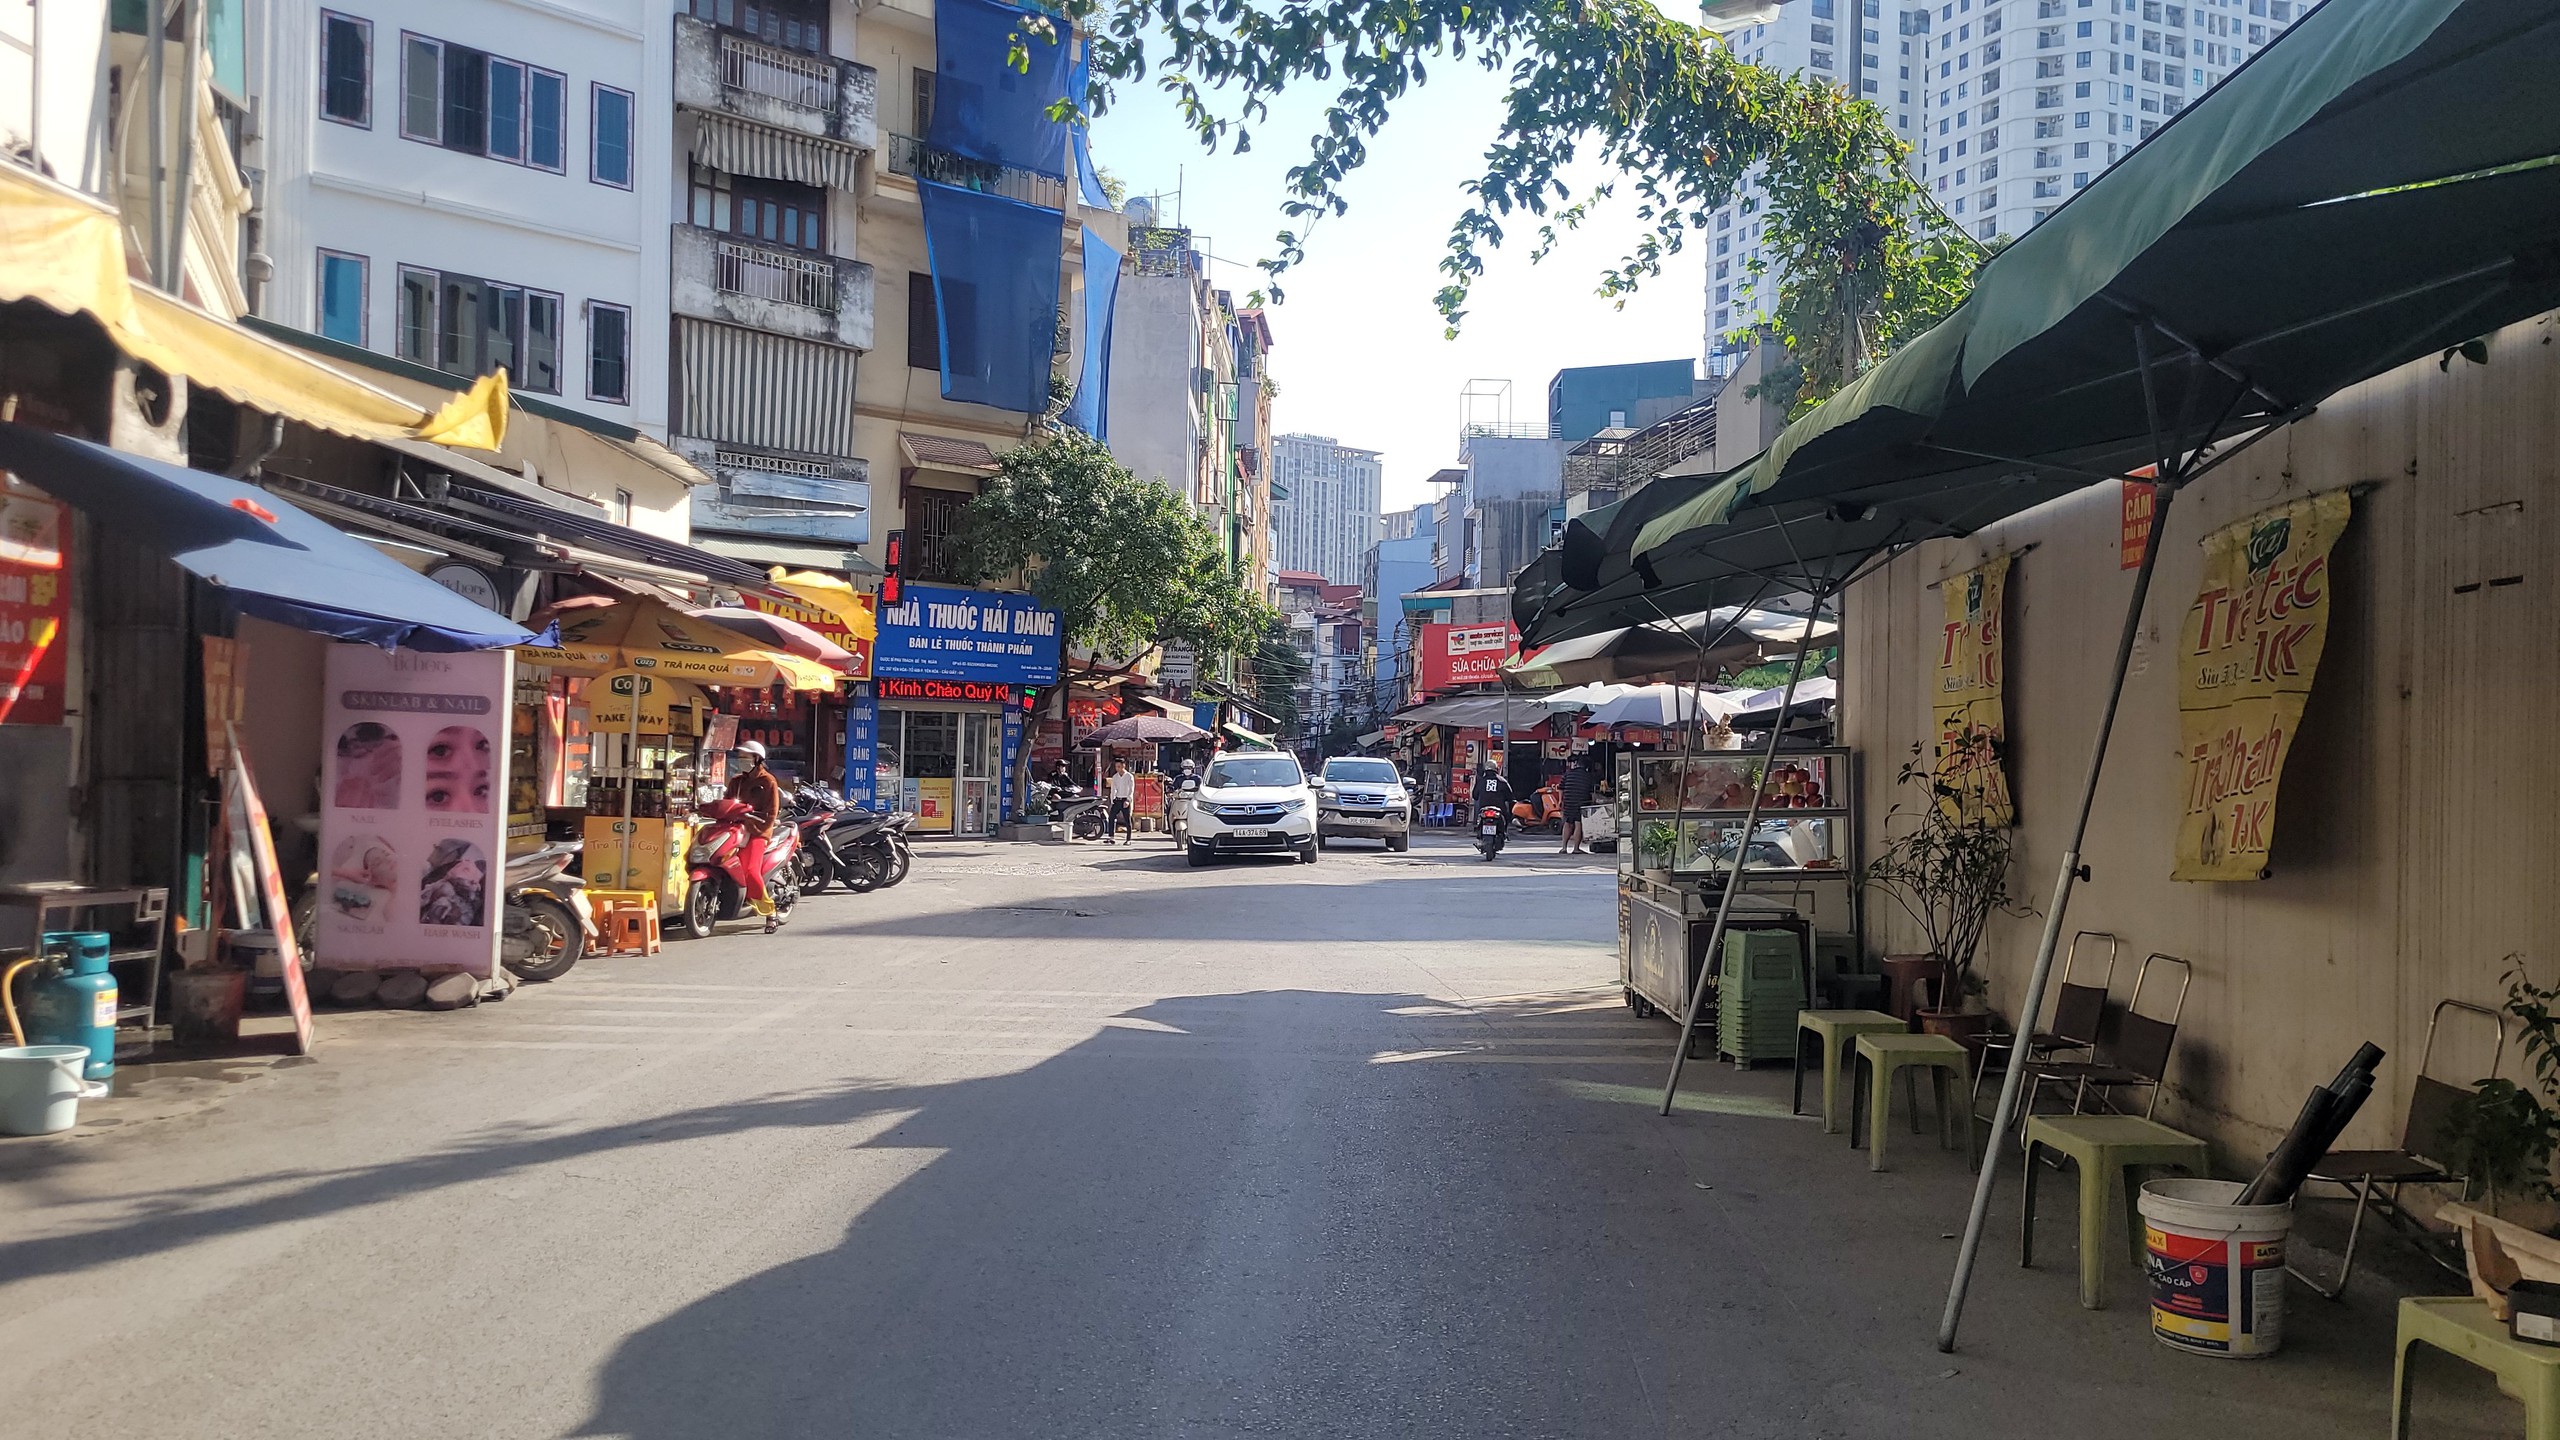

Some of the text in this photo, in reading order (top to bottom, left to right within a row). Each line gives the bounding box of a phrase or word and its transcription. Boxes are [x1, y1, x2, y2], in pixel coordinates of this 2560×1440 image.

[2125, 488, 2151, 521] CẤM
[928, 597, 979, 631] THUỐC
[982, 600, 1009, 634] HẢI
[1013, 606, 1056, 637] ĐĂNG
[908, 635, 929, 650] BÁN
[945, 636, 974, 652] THUỐC
[976, 640, 1005, 655] THÀNH
[1007, 638, 1033, 656] PHẨM
[542, 649, 564, 659] HOA
[635, 657, 730, 673] Cozy TRÀ HOA QUẢ
[1451, 656, 1470, 673] SỬA
[1470, 655, 1496, 672] CHỮA
[889, 680, 921, 696] Kính
[924, 682, 962, 698] Chào
[964, 684, 993, 702] Quý
[351, 695, 483, 712] SKINLAB & NAIL
[596, 713, 665, 726] TAKE WAY
[856, 724, 868, 740] HẢI
[852, 745, 870, 761] ĐĂNG
[855, 767, 868, 783] ĐẠT
[351, 814, 376, 825] NAIL
[428, 818, 484, 829] EYELASHES
[423, 928, 481, 941] HAIR WASH
[2158, 1273, 2192, 1288] CAO CẤP
